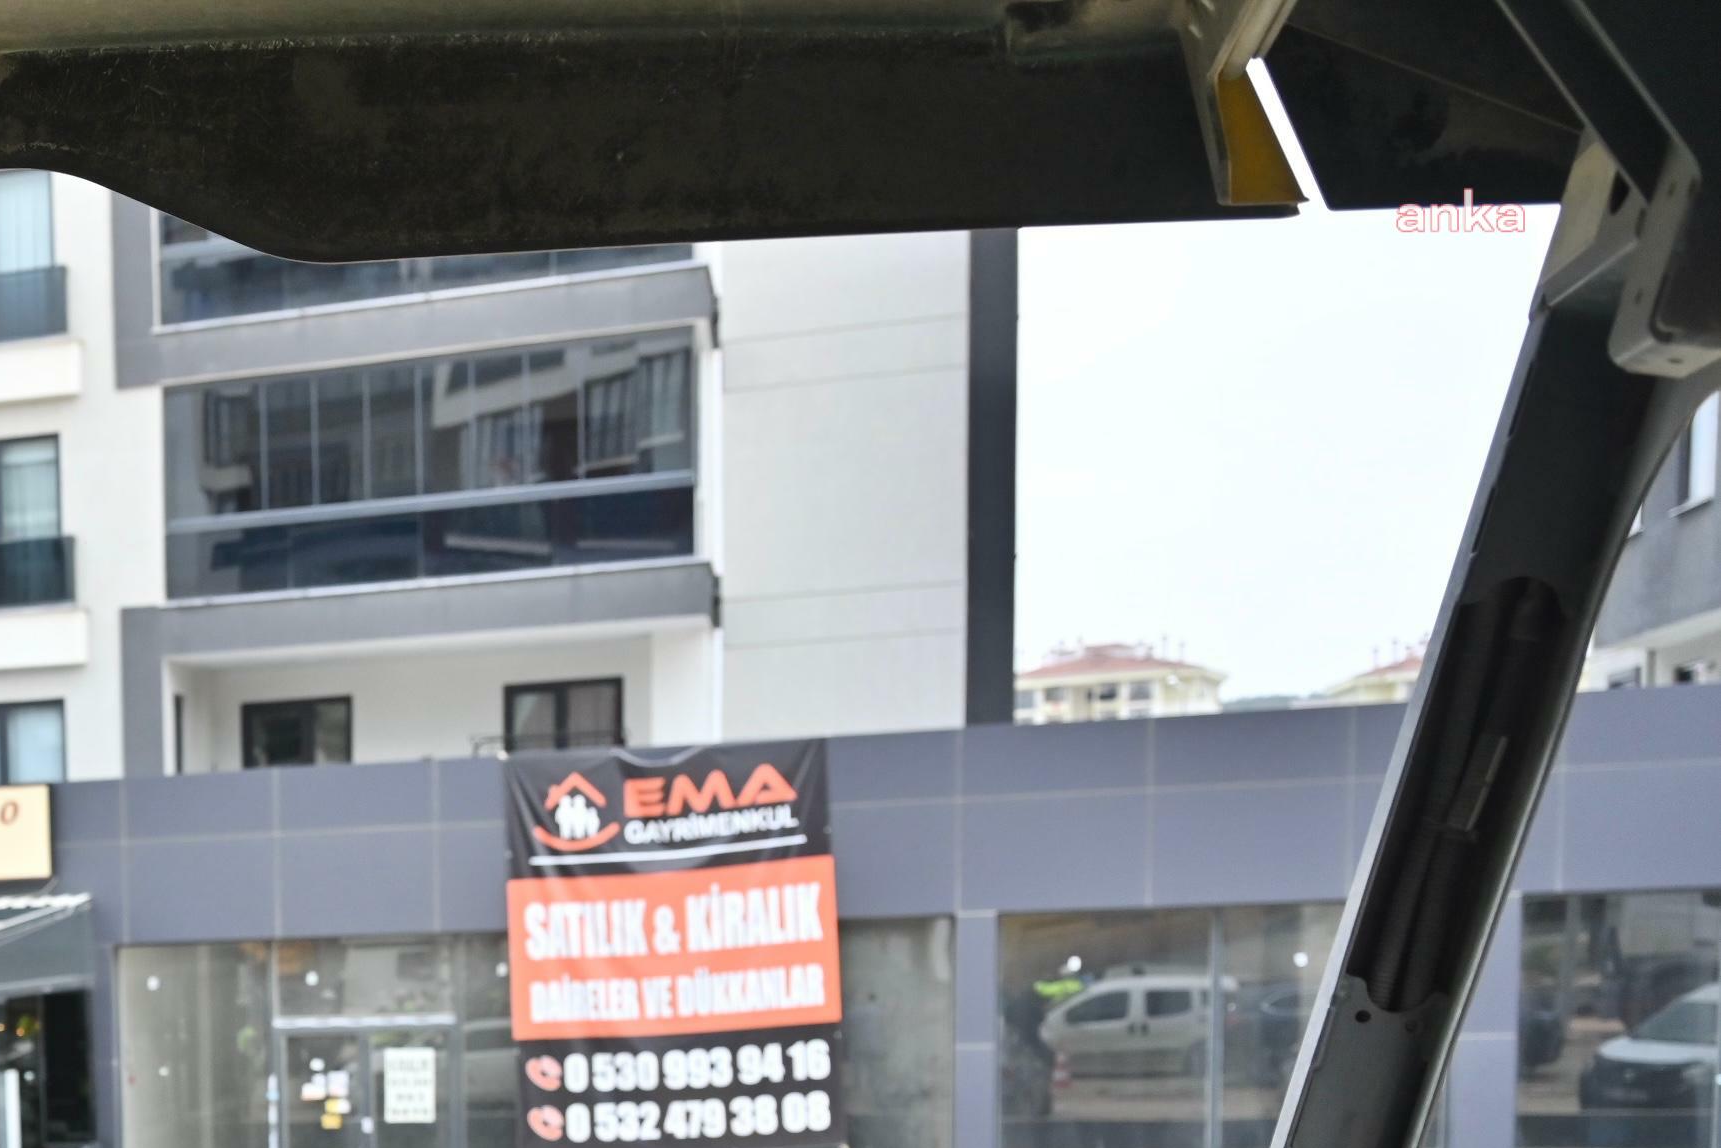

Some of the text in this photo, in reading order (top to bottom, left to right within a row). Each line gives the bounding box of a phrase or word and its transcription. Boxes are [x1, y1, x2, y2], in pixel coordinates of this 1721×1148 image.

[623, 763, 798, 817] EMA
[624, 804, 798, 844] GAYRİMENKUL
[525, 882, 823, 960] SATILIK & KİRALIK
[642, 976, 673, 1019] VE
[676, 964, 824, 1016] DÜKKANLAR
[564, 1053, 589, 1093] 0
[737, 1042, 785, 1085] 94
[565, 1103, 590, 1143] 0
[593, 1101, 661, 1142] 532
